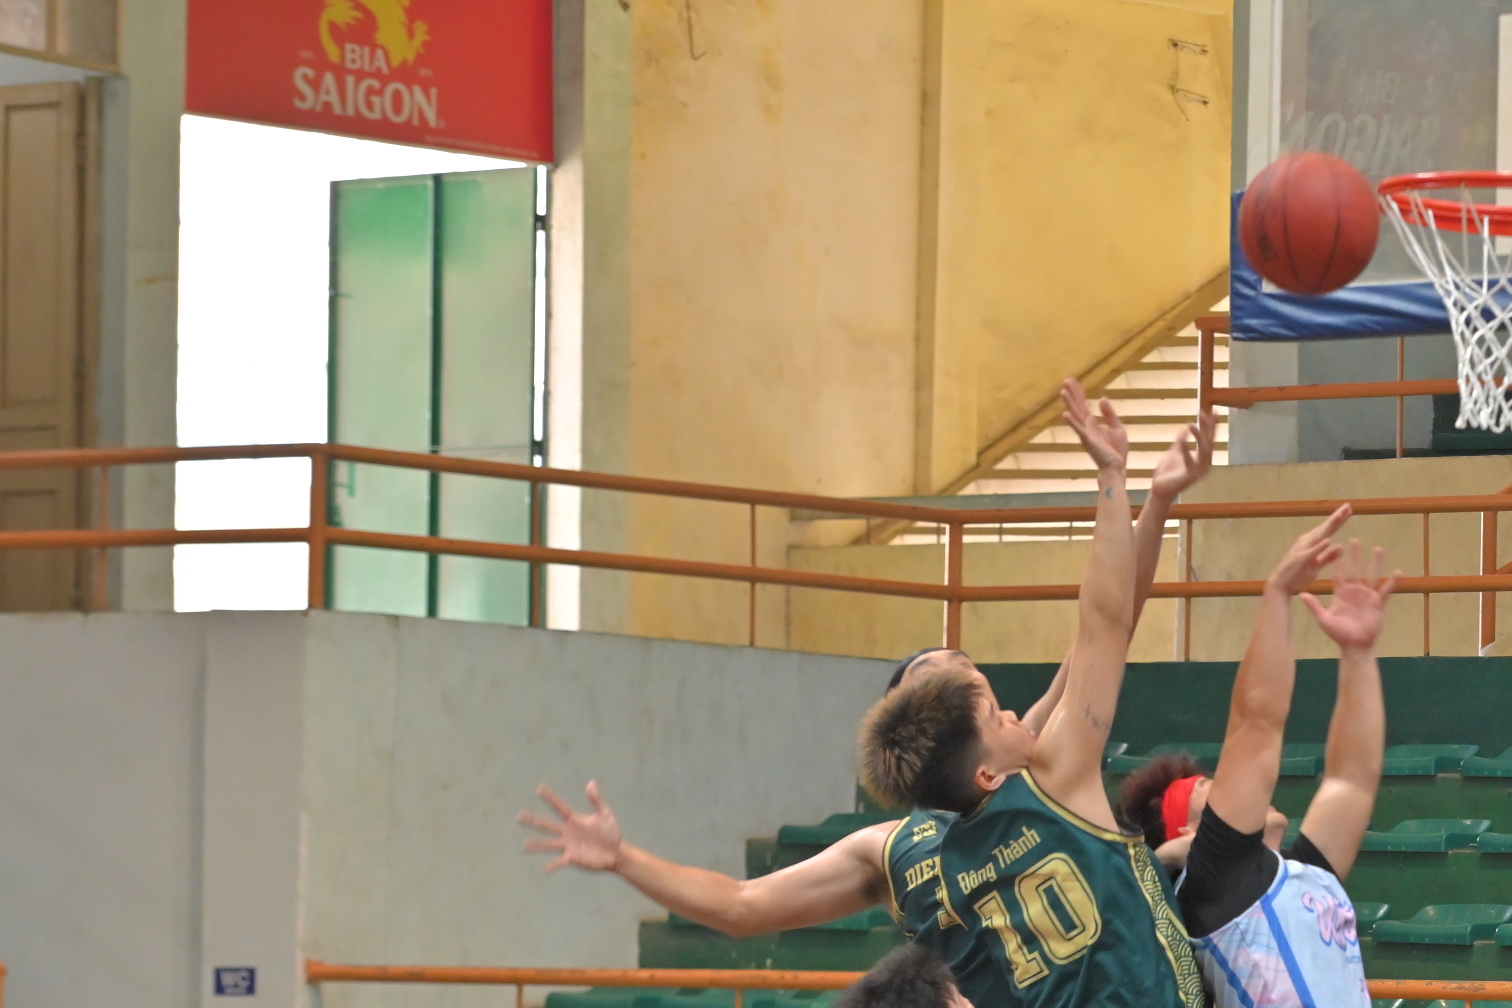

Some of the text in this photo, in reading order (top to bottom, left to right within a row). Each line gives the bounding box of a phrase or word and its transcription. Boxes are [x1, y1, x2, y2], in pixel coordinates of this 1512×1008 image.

[343, 42, 390, 75] BIA
[292, 65, 439, 128] SAIGON
[992, 825, 1042, 869] Thành
[972, 852, 1102, 990] 10
